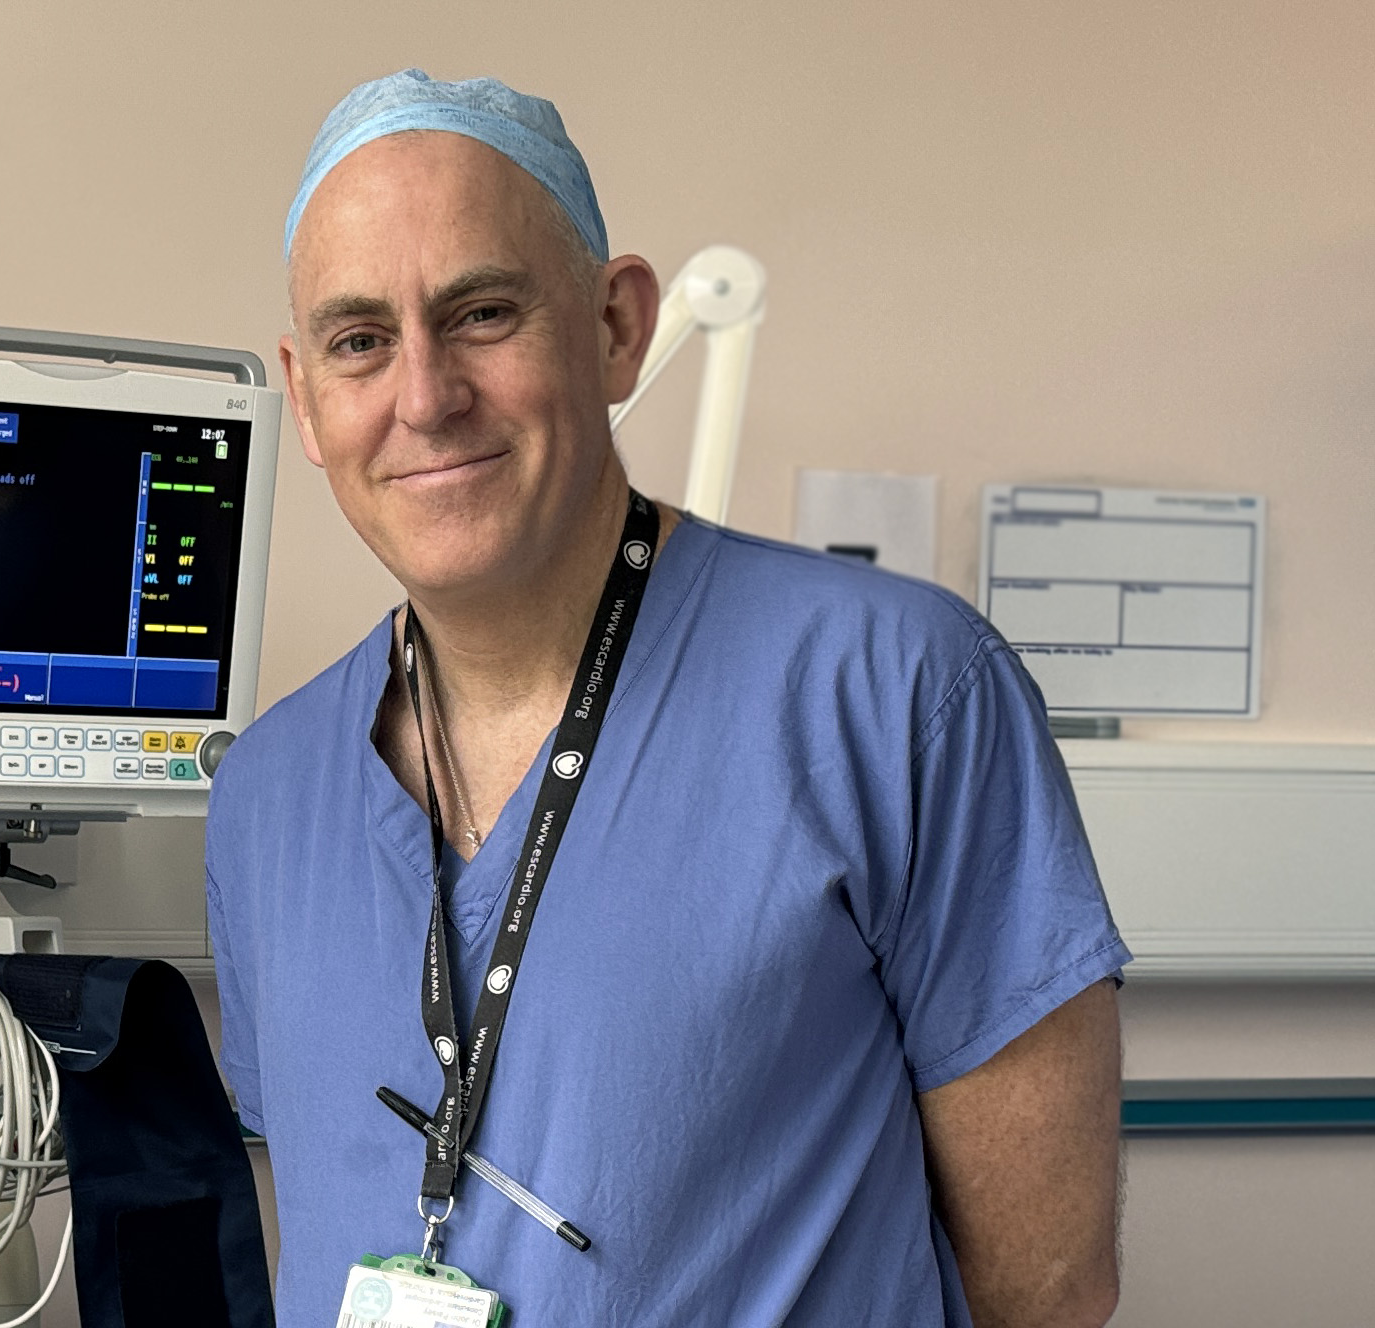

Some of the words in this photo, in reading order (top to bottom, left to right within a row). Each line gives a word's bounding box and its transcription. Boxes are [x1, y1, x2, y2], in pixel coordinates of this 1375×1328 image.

[201, 428, 225, 440] 12:07
[19, 474, 35, 485] off
[180, 536, 196, 547] OFF
[145, 553, 155, 564] V1
[178, 555, 194, 566] OFF
[177, 574, 193, 585] OFF
[574, 600, 625, 720] www.escardio.org
[508, 810, 555, 933] www.escardio.org
